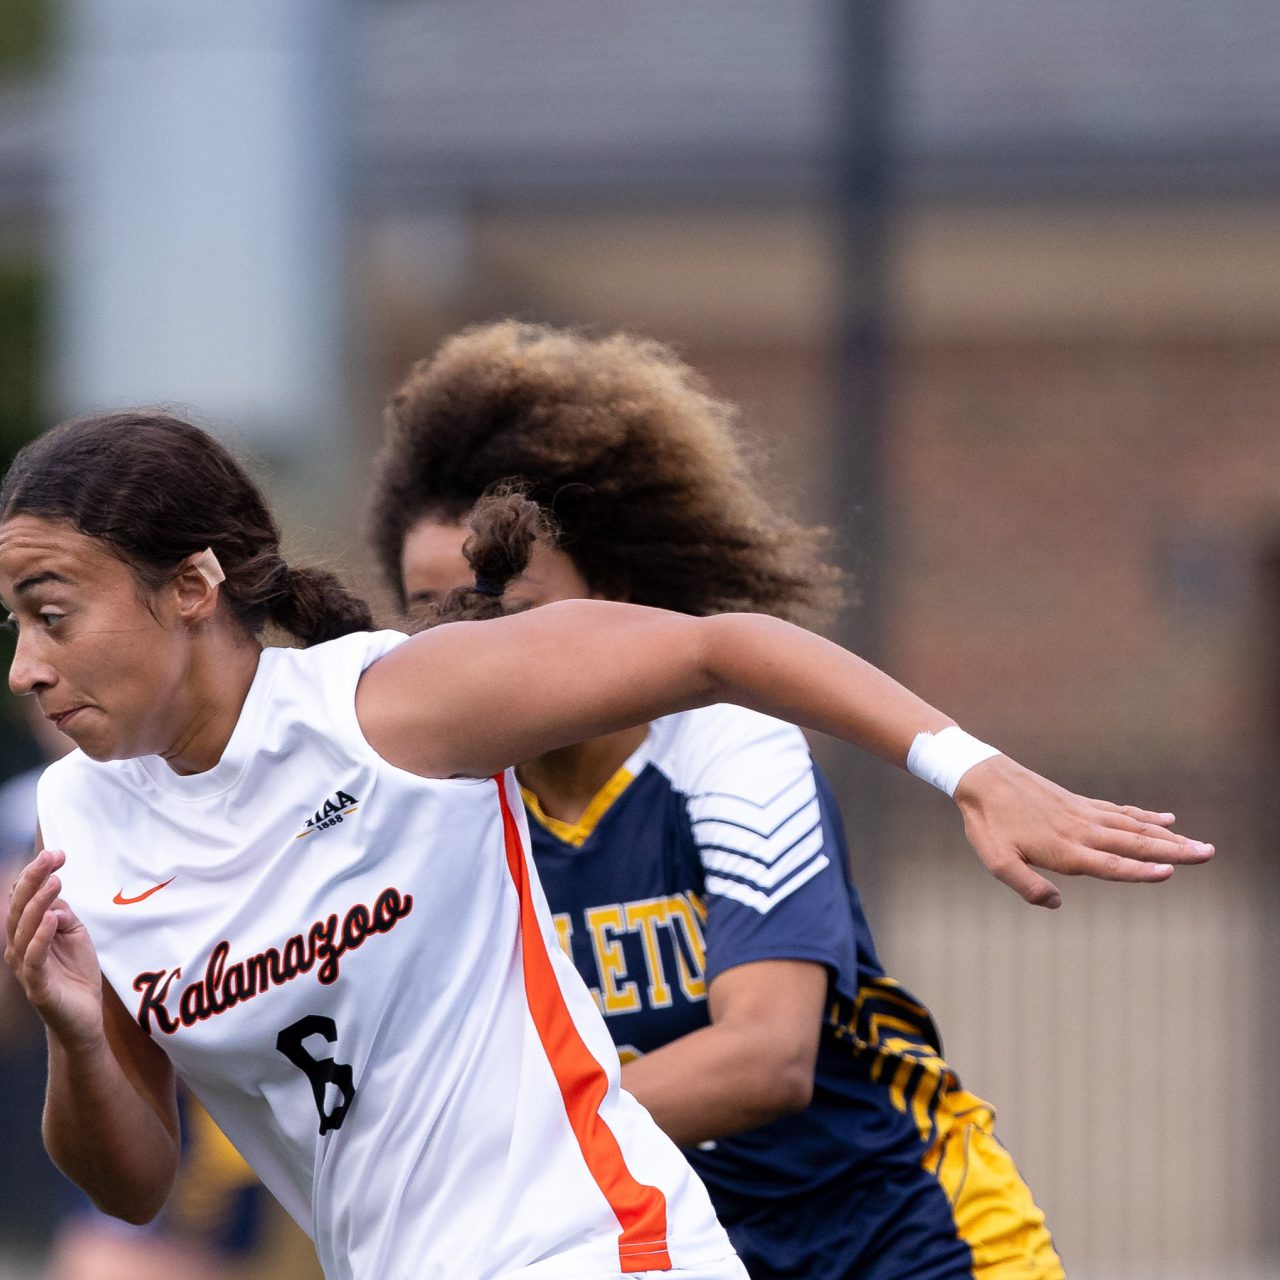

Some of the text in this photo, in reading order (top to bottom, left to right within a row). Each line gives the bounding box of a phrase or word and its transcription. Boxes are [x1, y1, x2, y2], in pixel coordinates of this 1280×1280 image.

[303, 790, 360, 827] IAA
[316, 814, 344, 831] 1888
[132, 886, 414, 1037] Kalamazoo
[552, 889, 708, 1017] ETO
[276, 1014, 356, 1136] 6
